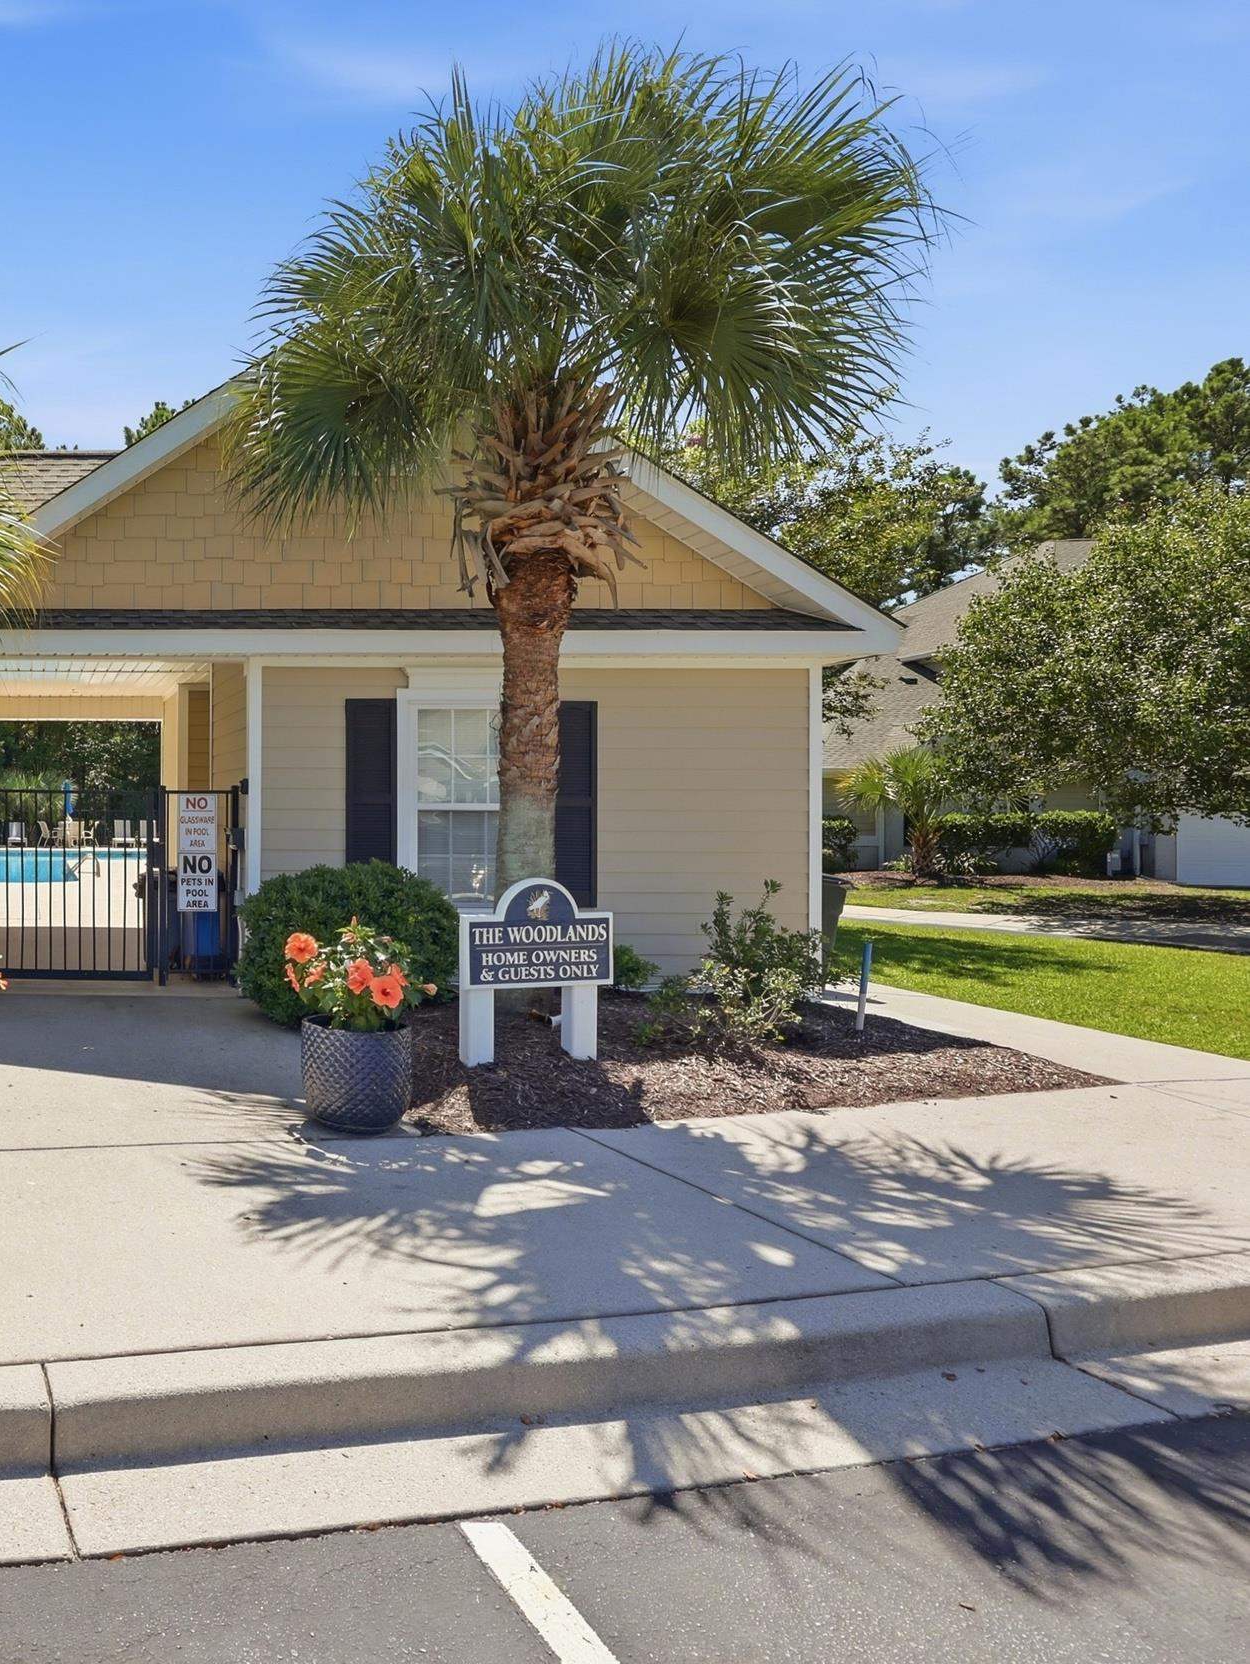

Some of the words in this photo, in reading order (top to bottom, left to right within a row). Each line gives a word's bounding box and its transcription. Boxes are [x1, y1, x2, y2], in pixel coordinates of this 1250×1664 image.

[186, 796, 208, 809] NO
[179, 815, 215, 824] GLASSWARE
[185, 828, 192, 836] IN
[190, 840, 206, 848] AREA
[182, 855, 212, 874] NO
[181, 878, 202, 886] PETS
[205, 878, 214, 886] IN
[186, 889, 209, 897] POOL
[186, 900, 209, 908] AREA
[472, 927, 503, 945] THE
[507, 923, 607, 944] WOODLANDS
[481, 951, 528, 966] HOME
[532, 949, 597, 964] OWNERS
[480, 968, 494, 981] &
[498, 966, 555, 981] GUESTS
[559, 964, 599, 978] ONLY
